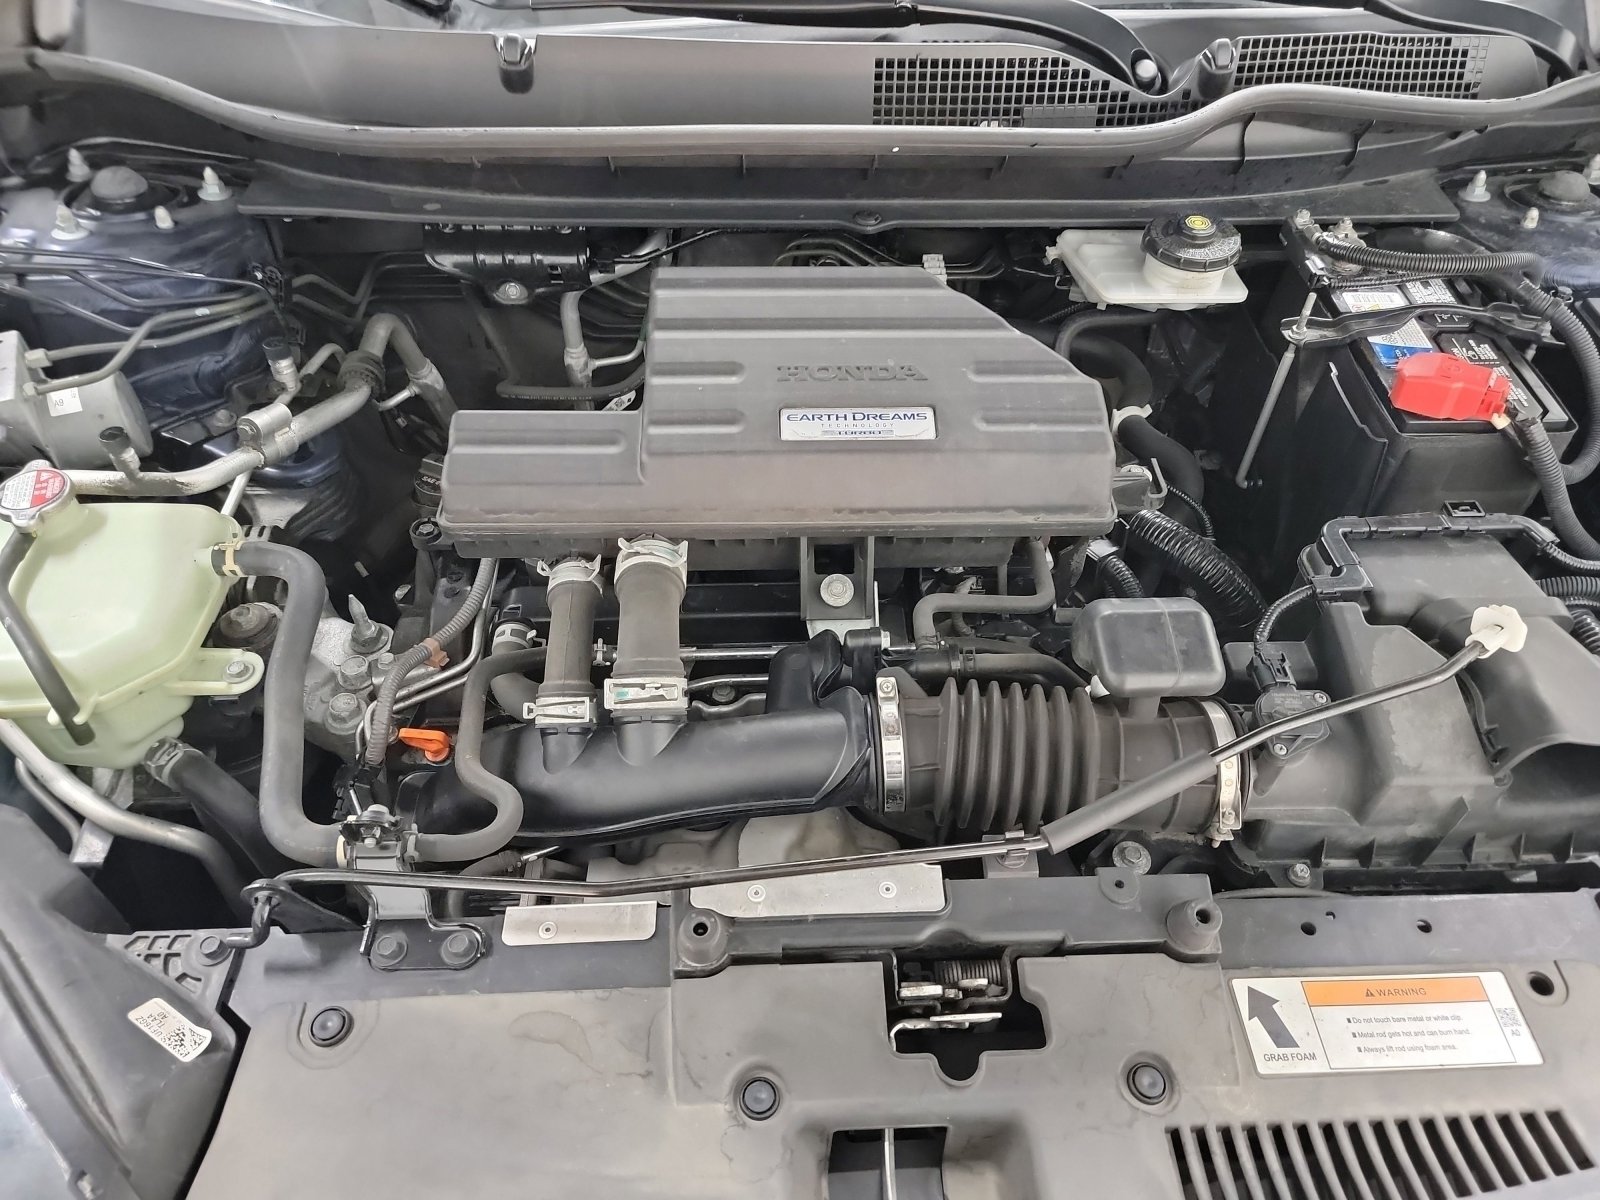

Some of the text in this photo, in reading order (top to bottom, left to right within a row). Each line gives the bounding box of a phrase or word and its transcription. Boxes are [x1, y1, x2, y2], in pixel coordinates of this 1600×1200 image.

[776, 365, 929, 382] HONDA
[786, 412, 928, 421] EARTH DREAMS
[1375, 987, 1427, 998] WARNING
[1352, 1016, 1362, 1024] Do
[1391, 1015, 1406, 1023] bare
[1387, 1031, 1401, 1039] gets
[1438, 1028, 1453, 1036] burn
[1363, 1046, 1386, 1054] Always
[1406, 1044, 1425, 1053] using
[1263, 1052, 1317, 1062] GRAB FOAM
